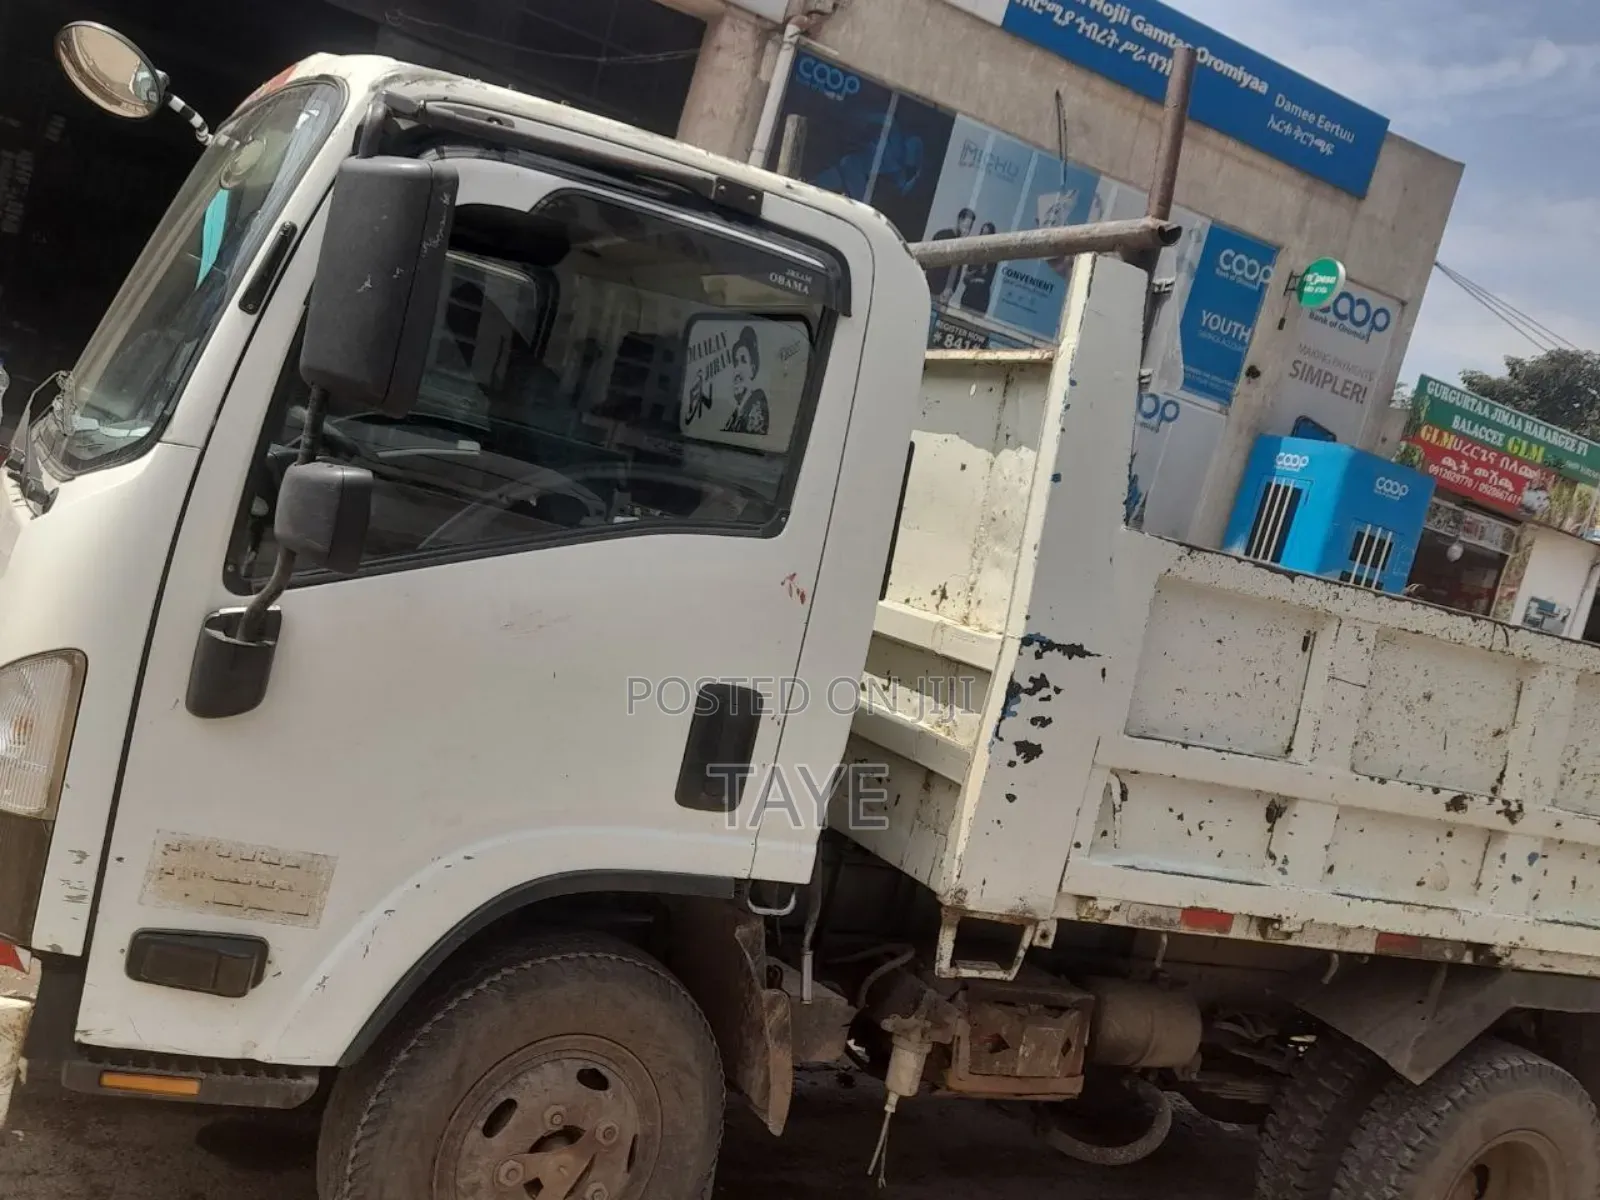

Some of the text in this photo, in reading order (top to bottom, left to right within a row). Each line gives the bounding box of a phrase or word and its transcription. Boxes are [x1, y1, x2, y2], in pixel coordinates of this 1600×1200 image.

[1275, 93, 1355, 144] Damee Eertuu
[769, 272, 810, 295] OBAMA
[1201, 309, 1252, 343] YOUTH
[1309, 311, 1329, 326] Bank
[1289, 359, 1369, 405] SIMPLER!
[1419, 423, 1456, 450] GLM
[1507, 435, 1546, 464] GLM
